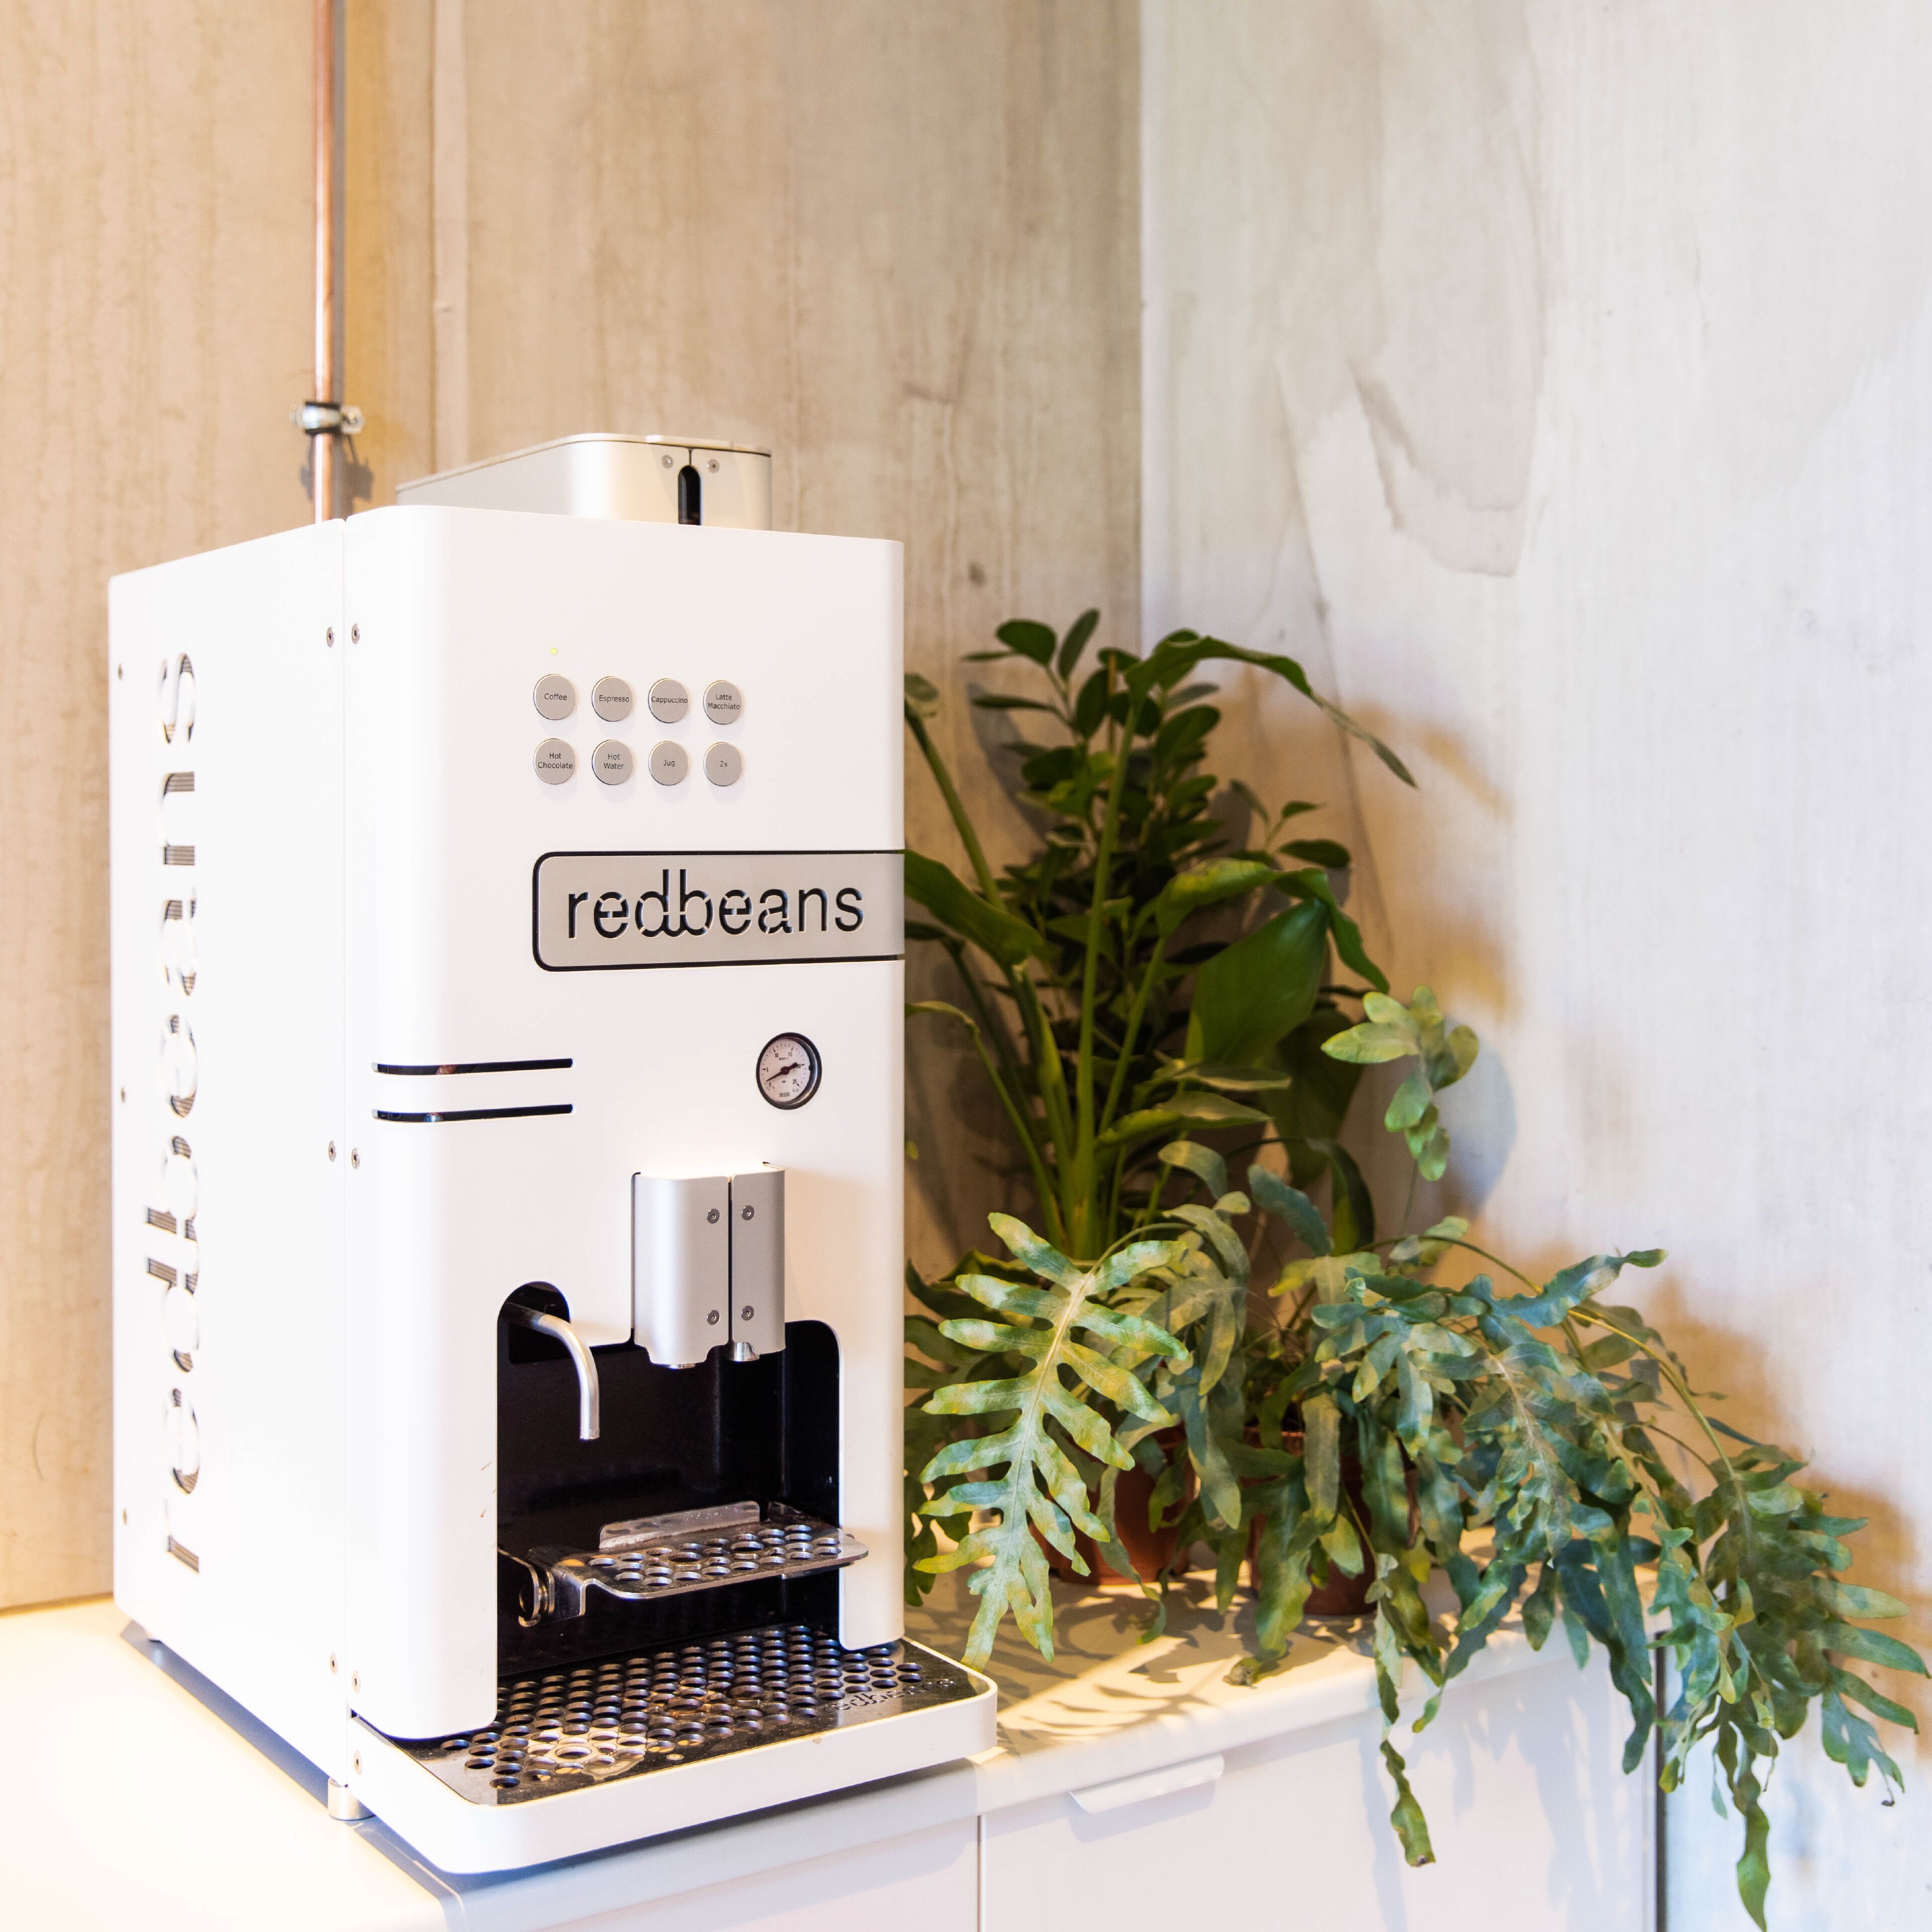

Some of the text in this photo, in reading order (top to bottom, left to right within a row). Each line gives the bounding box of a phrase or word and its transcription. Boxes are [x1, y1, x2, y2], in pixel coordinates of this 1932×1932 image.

[599, 695, 629, 703] Espresso
[651, 696, 688, 704] Cappuccino
[538, 761, 573, 769] Chocolate
[568, 869, 864, 939] redbeans
[143, 653, 199, 1574] redbeans
